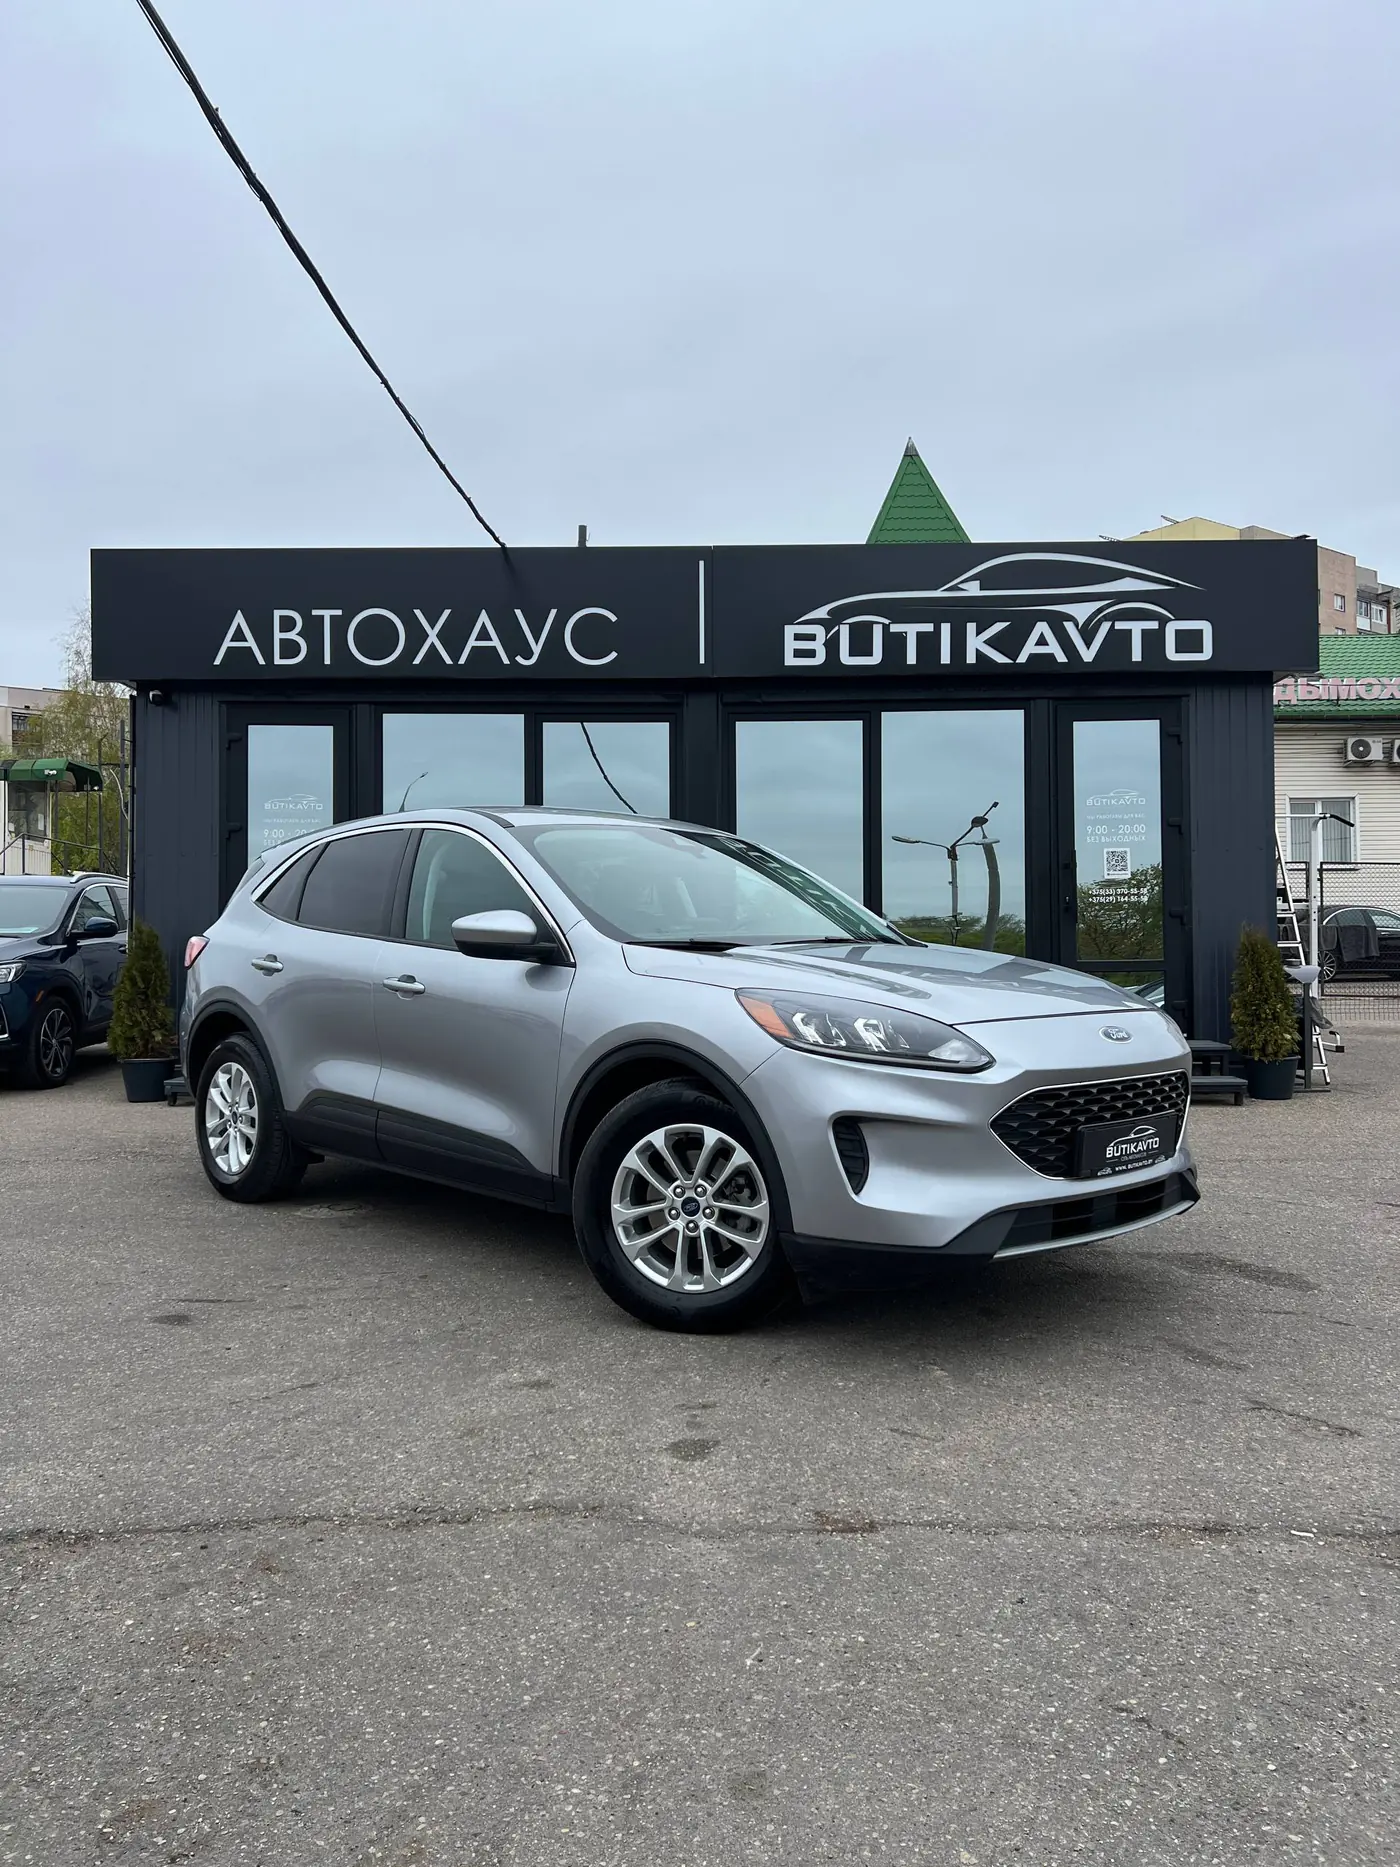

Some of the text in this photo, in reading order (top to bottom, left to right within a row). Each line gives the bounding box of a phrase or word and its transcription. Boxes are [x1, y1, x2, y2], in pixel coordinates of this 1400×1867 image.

[213, 607, 619, 666] АВТОХАУС
[784, 619, 1213, 667] BUTIKAVTO
[1273, 676, 1400, 705] ДЫМОХ
[264, 802, 323, 810] BUTIKAVTO
[1086, 797, 1146, 806] BUTIKAVTO
[264, 829, 284, 838] 9:00
[1086, 825, 1108, 835] 9:00
[1118, 823, 1146, 834] 20:00
[1101, 835, 1146, 843] ВЫХОДНЫХ
[1107, 1028, 1129, 1039] Ford
[1106, 1137, 1159, 1158] BUTIKAVTO
